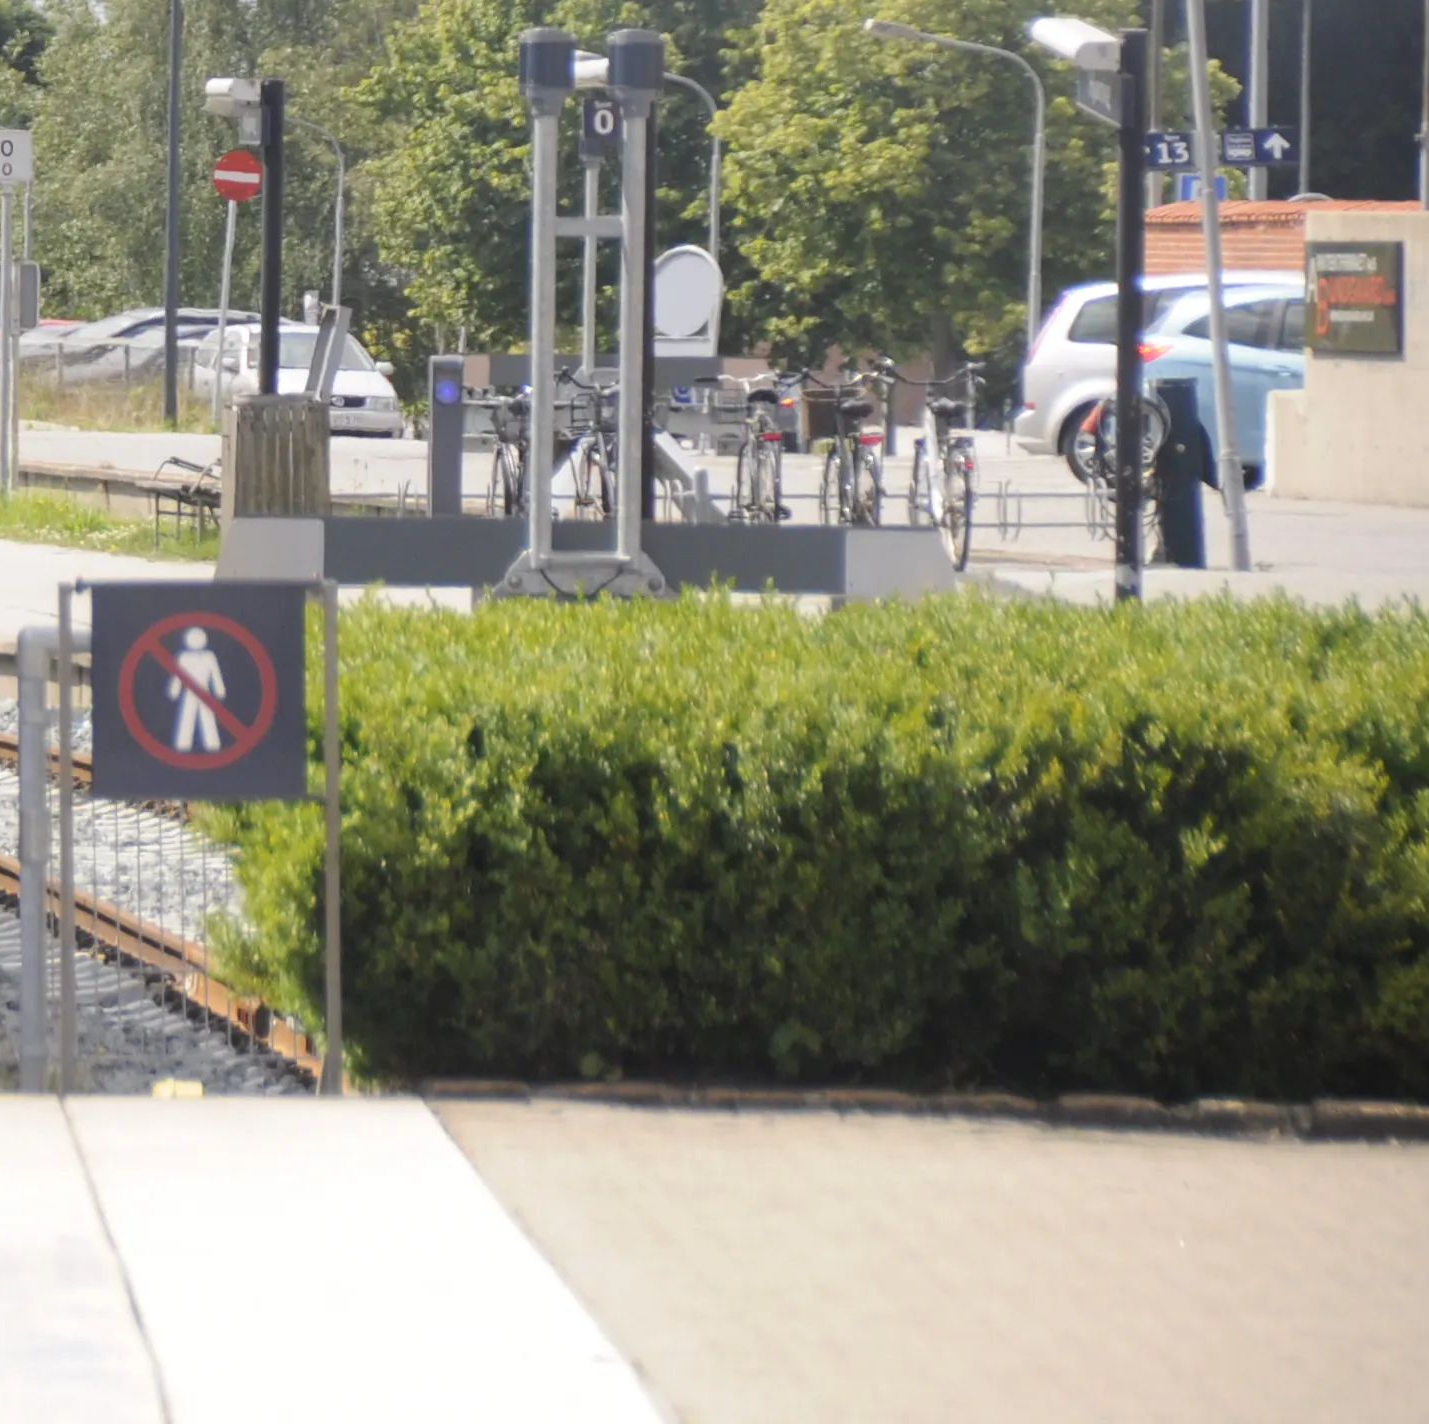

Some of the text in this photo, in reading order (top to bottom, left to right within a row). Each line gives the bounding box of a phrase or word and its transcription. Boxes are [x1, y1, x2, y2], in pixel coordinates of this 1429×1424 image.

[594, 109, 614, 135] 0
[1, 140, 14, 157] 0
[1157, 142, 1190, 163] 13
